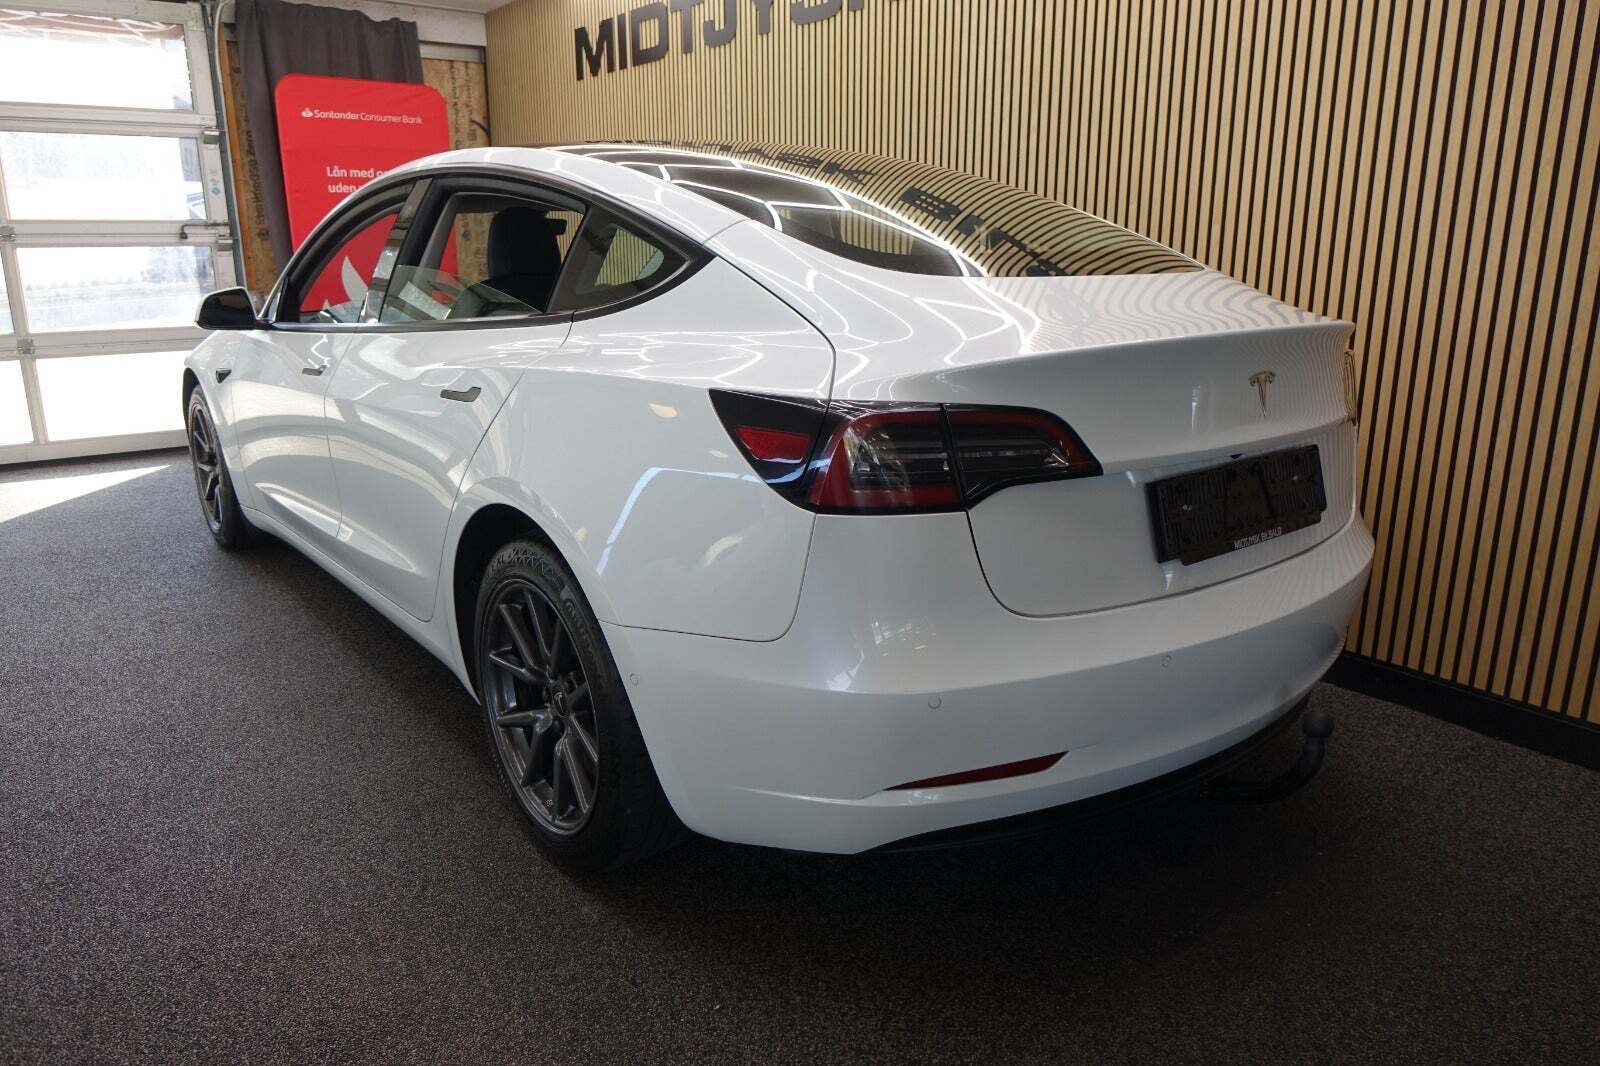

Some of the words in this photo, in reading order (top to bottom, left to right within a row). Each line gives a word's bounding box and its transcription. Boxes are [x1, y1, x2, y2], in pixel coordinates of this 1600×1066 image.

[314, 109, 360, 120] Santander
[360, 112, 401, 123] Consumer
[402, 115, 423, 124] Bank
[326, 165, 347, 177] Lån
[349, 167, 374, 178] med
[328, 183, 356, 193] uden
